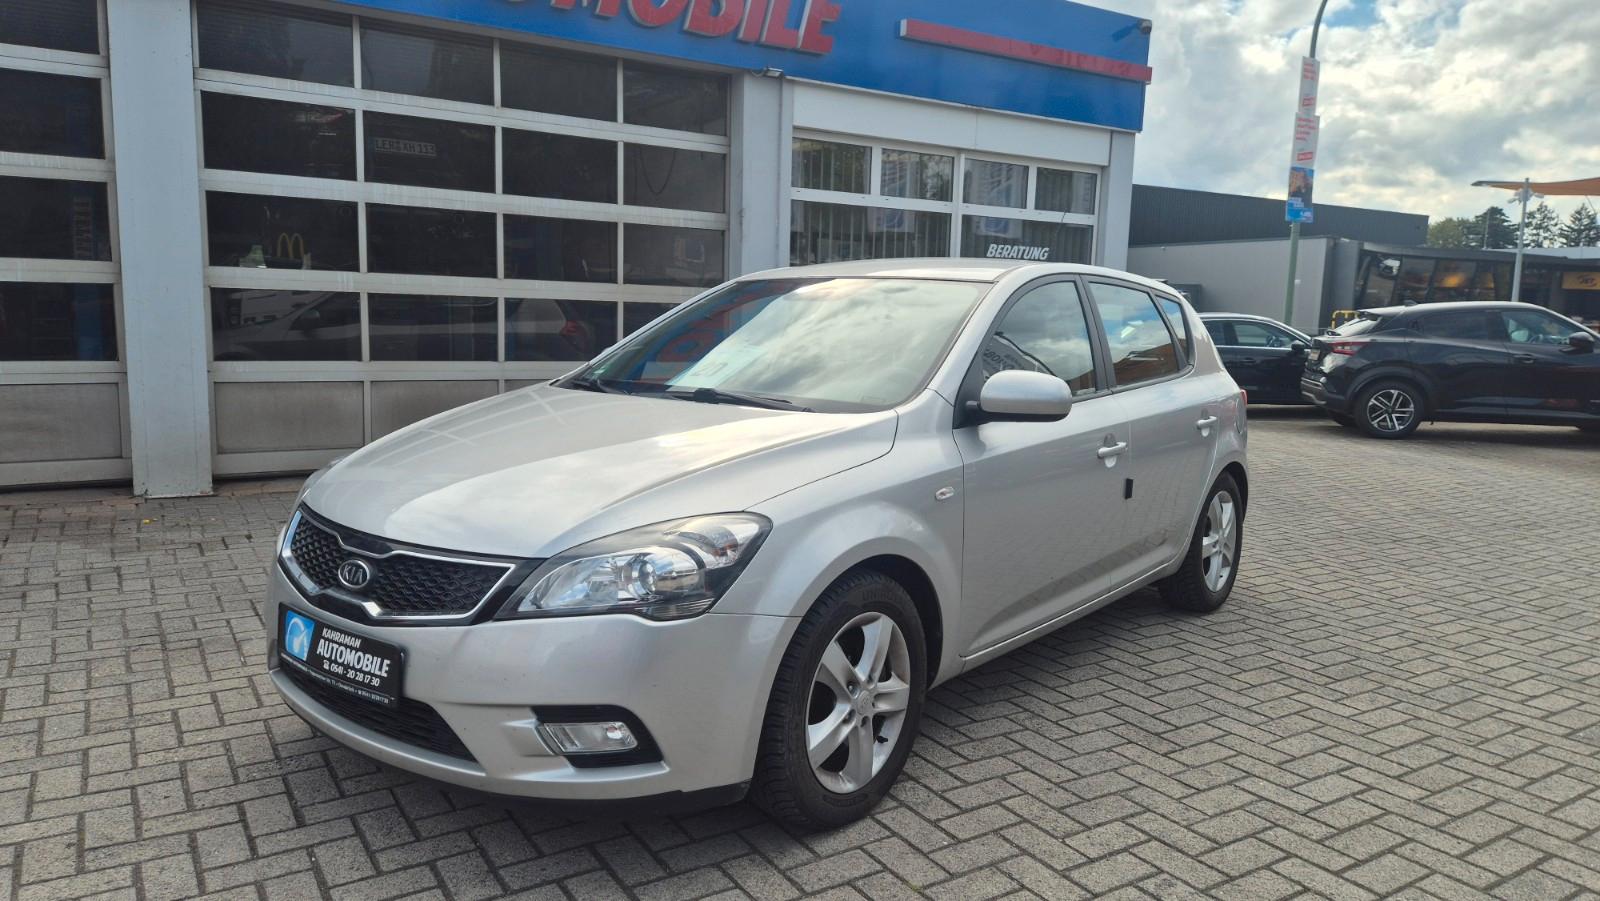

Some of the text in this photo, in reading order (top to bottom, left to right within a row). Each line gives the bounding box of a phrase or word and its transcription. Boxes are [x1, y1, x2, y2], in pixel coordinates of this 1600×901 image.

[986, 243, 1050, 260] BERATUNG
[322, 627, 361, 649] KAHRAMAN
[316, 639, 391, 677] AUTOMOBILE
[330, 663, 343, 675] 0541
[346, 669, 356, 679] 20
[355, 672, 364, 682] 28
[364, 674, 371, 684] 17
[370, 676, 380, 687] 30
